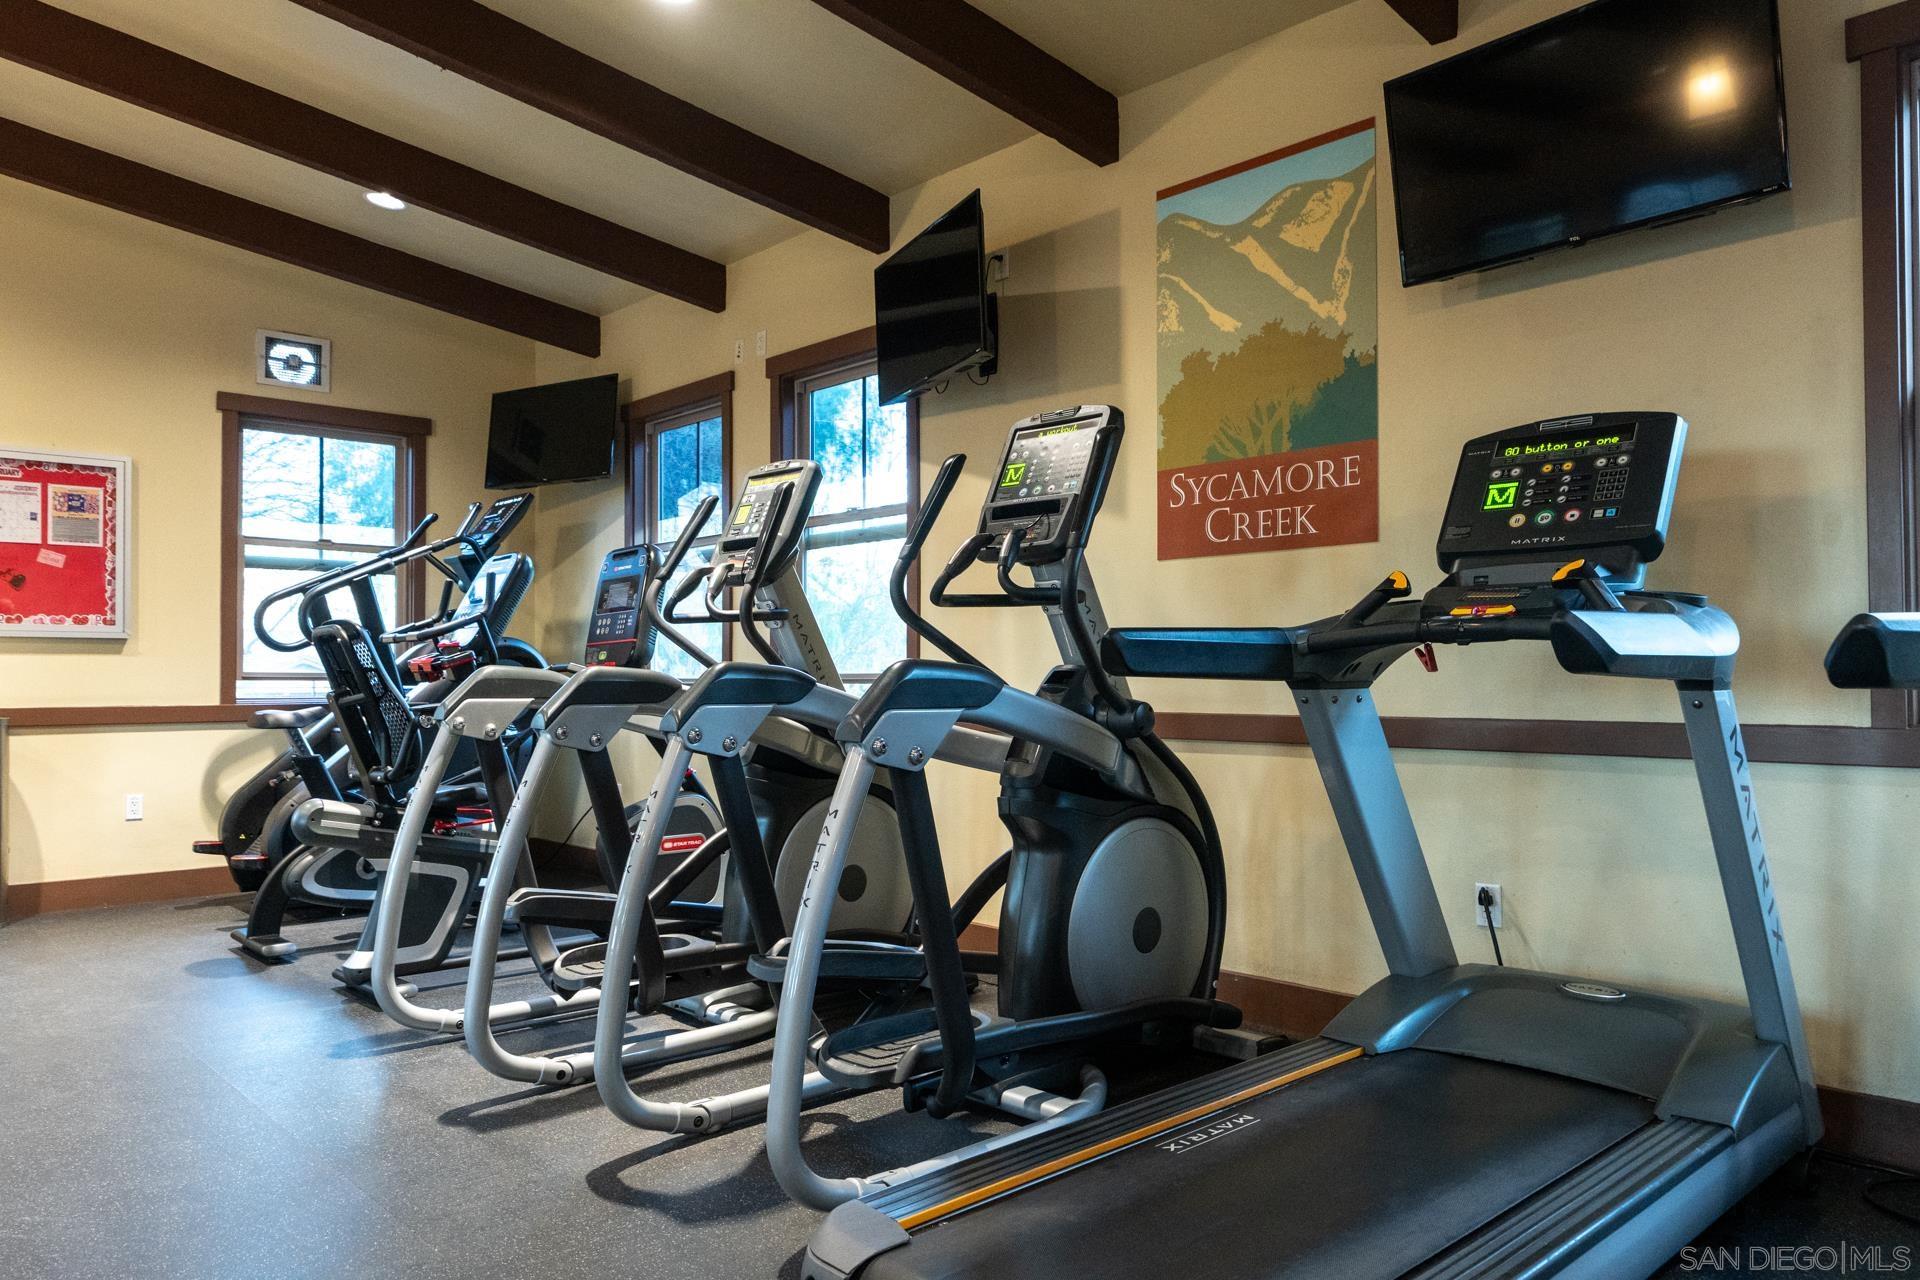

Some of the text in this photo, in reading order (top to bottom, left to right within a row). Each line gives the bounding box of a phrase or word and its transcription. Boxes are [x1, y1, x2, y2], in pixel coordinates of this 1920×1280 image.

[1047, 424, 1079, 435] workout
[1525, 442, 1568, 454] button
[1574, 440, 1590, 448] or
[1596, 436, 1620, 445] one
[1169, 455, 1361, 508] SYCAMORE
[1205, 504, 1319, 543] CREEK
[1510, 536, 1566, 544] MATRIX
[793, 614, 829, 686] MATRI
[1730, 725, 1783, 955] MATRIX
[1161, 1113, 1255, 1152] MATRIX
